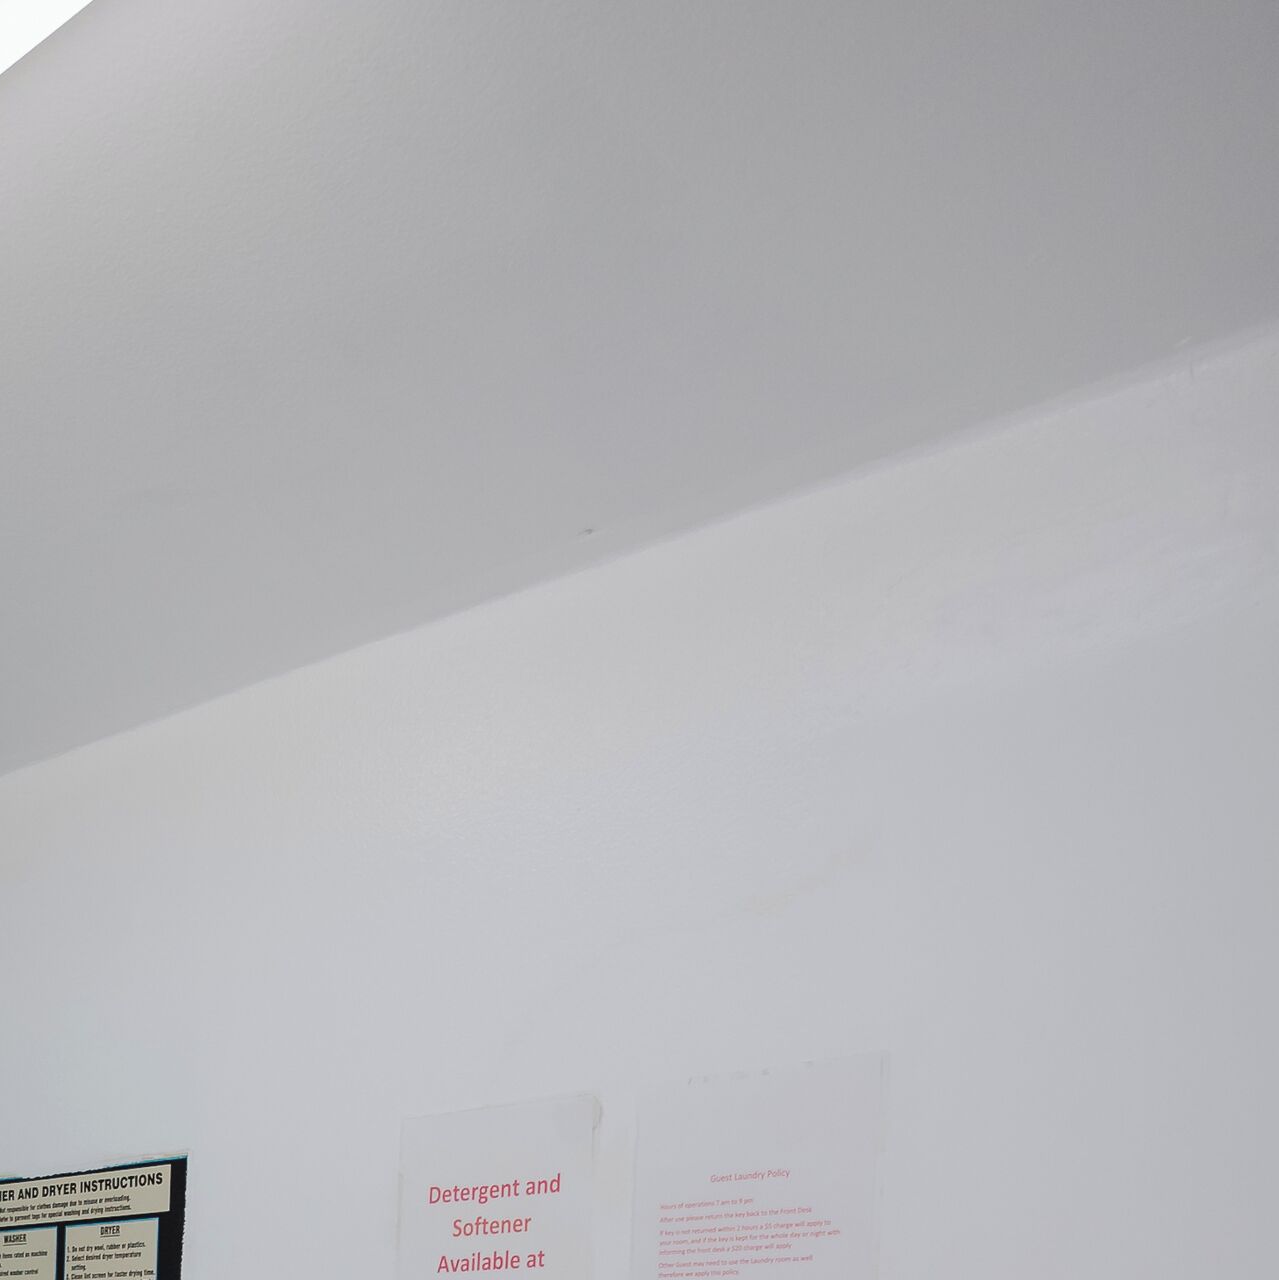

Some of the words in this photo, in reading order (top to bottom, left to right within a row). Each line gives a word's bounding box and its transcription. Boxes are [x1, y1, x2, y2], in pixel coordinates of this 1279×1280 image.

[17, 1187, 39, 1200] AND
[42, 1183, 77, 1197] DRYER
[80, 1174, 163, 1193] INSTRUCTIONS
[710, 1173, 732, 1182] Guest
[734, 1172, 765, 1180] Laundry
[767, 1170, 790, 1179] Policy
[428, 1179, 520, 1205] Detergent
[525, 1173, 561, 1196] and
[100, 1226, 120, 1235] DRYER
[452, 1215, 531, 1238] Softener
[4, 1234, 27, 1243] WASHER
[437, 1248, 520, 1274] Available
[526, 1250, 545, 1269] at
